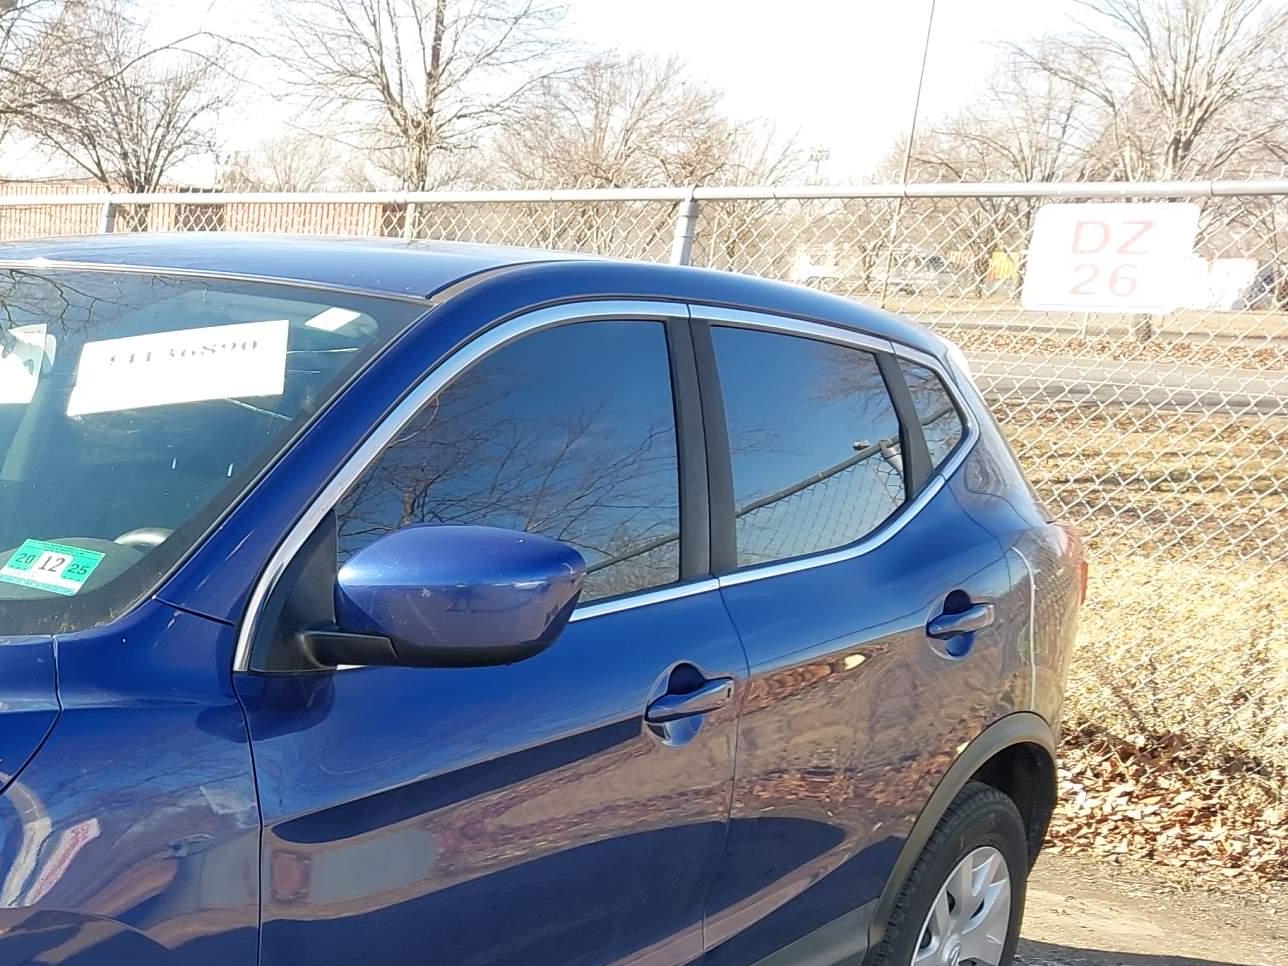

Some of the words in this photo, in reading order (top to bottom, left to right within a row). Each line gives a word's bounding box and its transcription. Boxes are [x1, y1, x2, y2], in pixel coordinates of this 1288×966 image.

[1071, 220, 1157, 256] DZ
[1069, 263, 1139, 298] 26
[15, 552, 36, 564] 20
[37, 554, 66, 573] 12
[67, 563, 89, 575] 25
